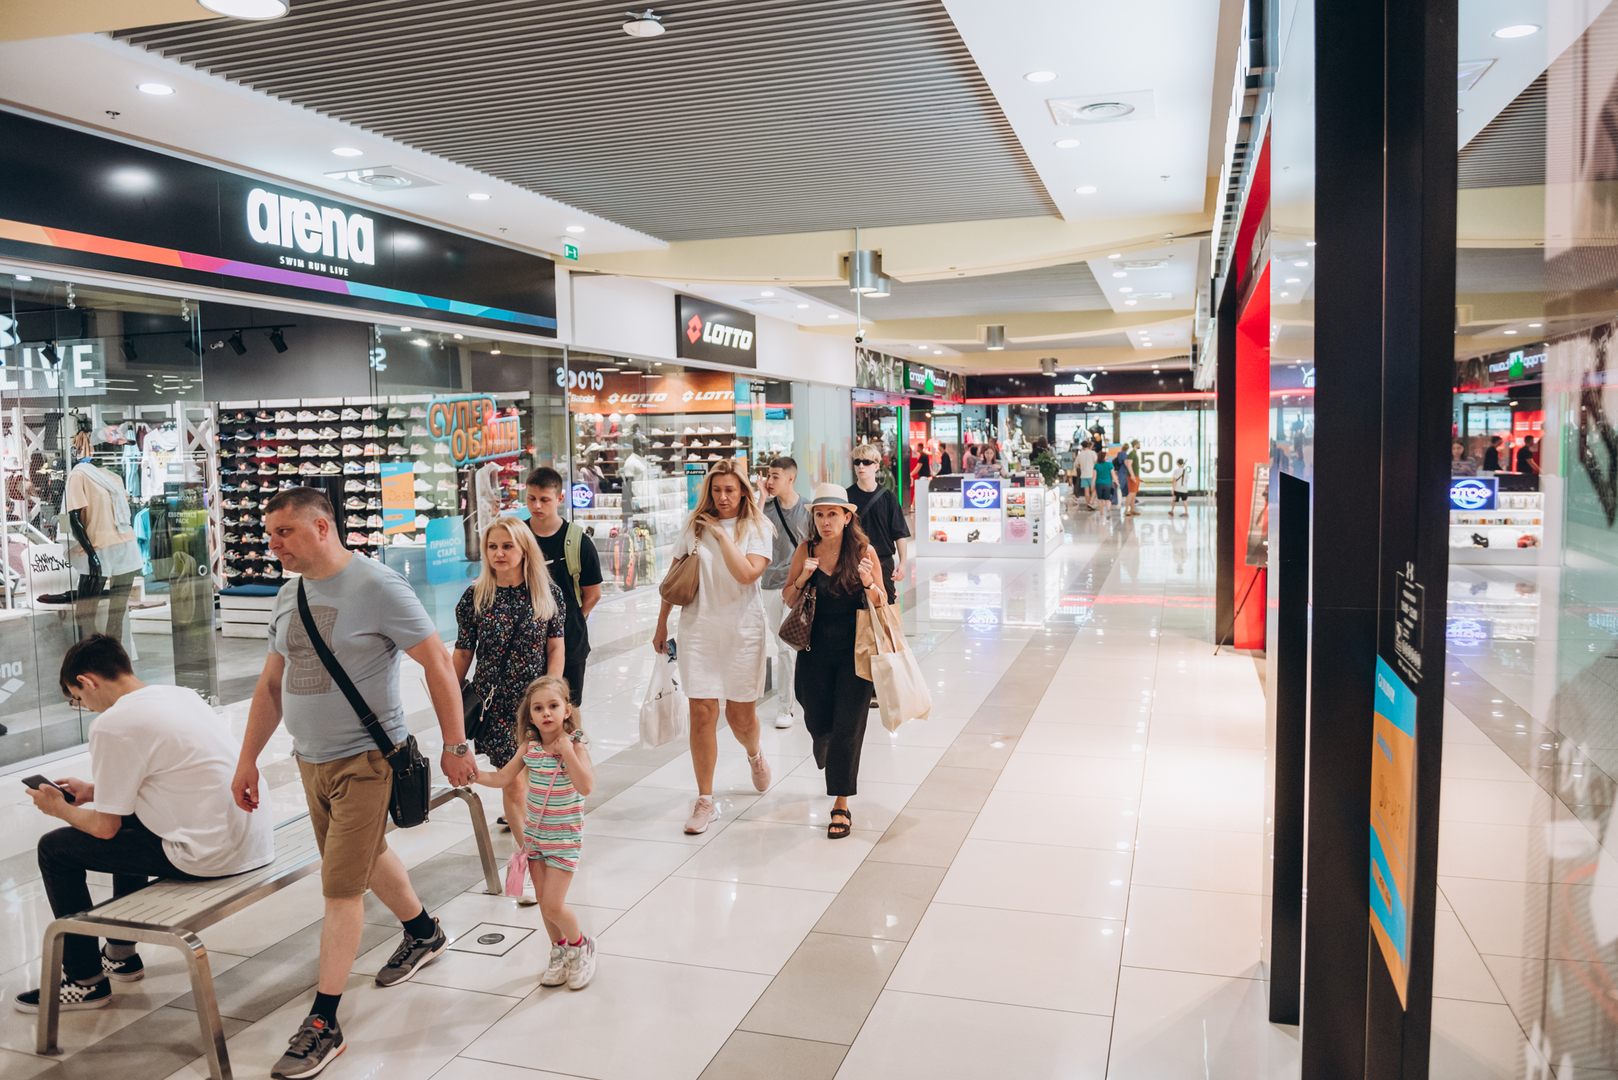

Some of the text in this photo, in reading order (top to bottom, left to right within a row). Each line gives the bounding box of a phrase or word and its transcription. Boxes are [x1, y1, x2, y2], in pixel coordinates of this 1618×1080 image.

[246, 188, 375, 266] arena
[279, 255, 349, 277] SWIM RUN LIVE
[702, 321, 753, 351] LOTTO
[0, 344, 94, 391] LIVE
[620, 392, 668, 403] LOTTO
[429, 398, 495, 439] СУПЕР
[451, 420, 519, 463] ОБМІН
[430, 537, 462, 550] ПРИНОСЬ
[437, 547, 457, 558] СТАРЕ
